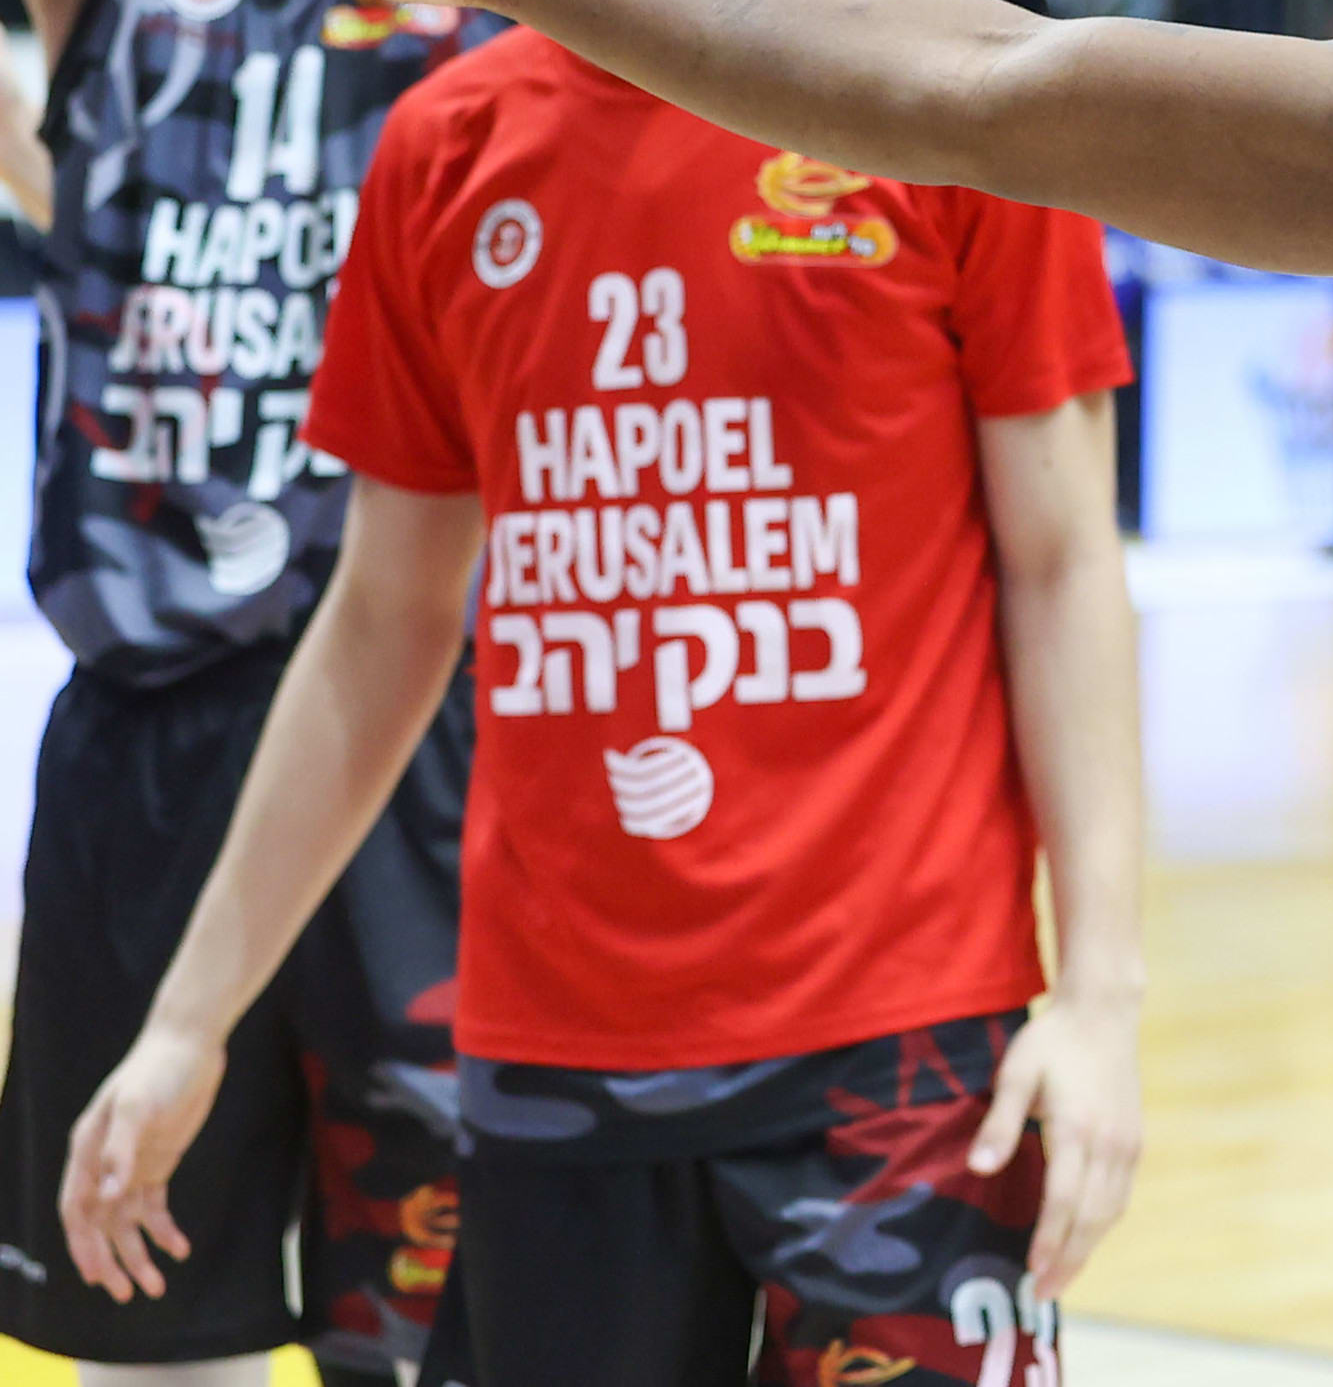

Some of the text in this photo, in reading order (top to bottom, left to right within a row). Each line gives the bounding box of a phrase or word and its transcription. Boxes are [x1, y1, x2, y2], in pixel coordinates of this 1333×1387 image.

[225, 44, 327, 201] 14
[588, 267, 688, 391] 23
[516, 397, 793, 504] HAPOEL
[486, 492, 859, 608] JERUSALEM
[489, 598, 867, 733] בנק יהב
